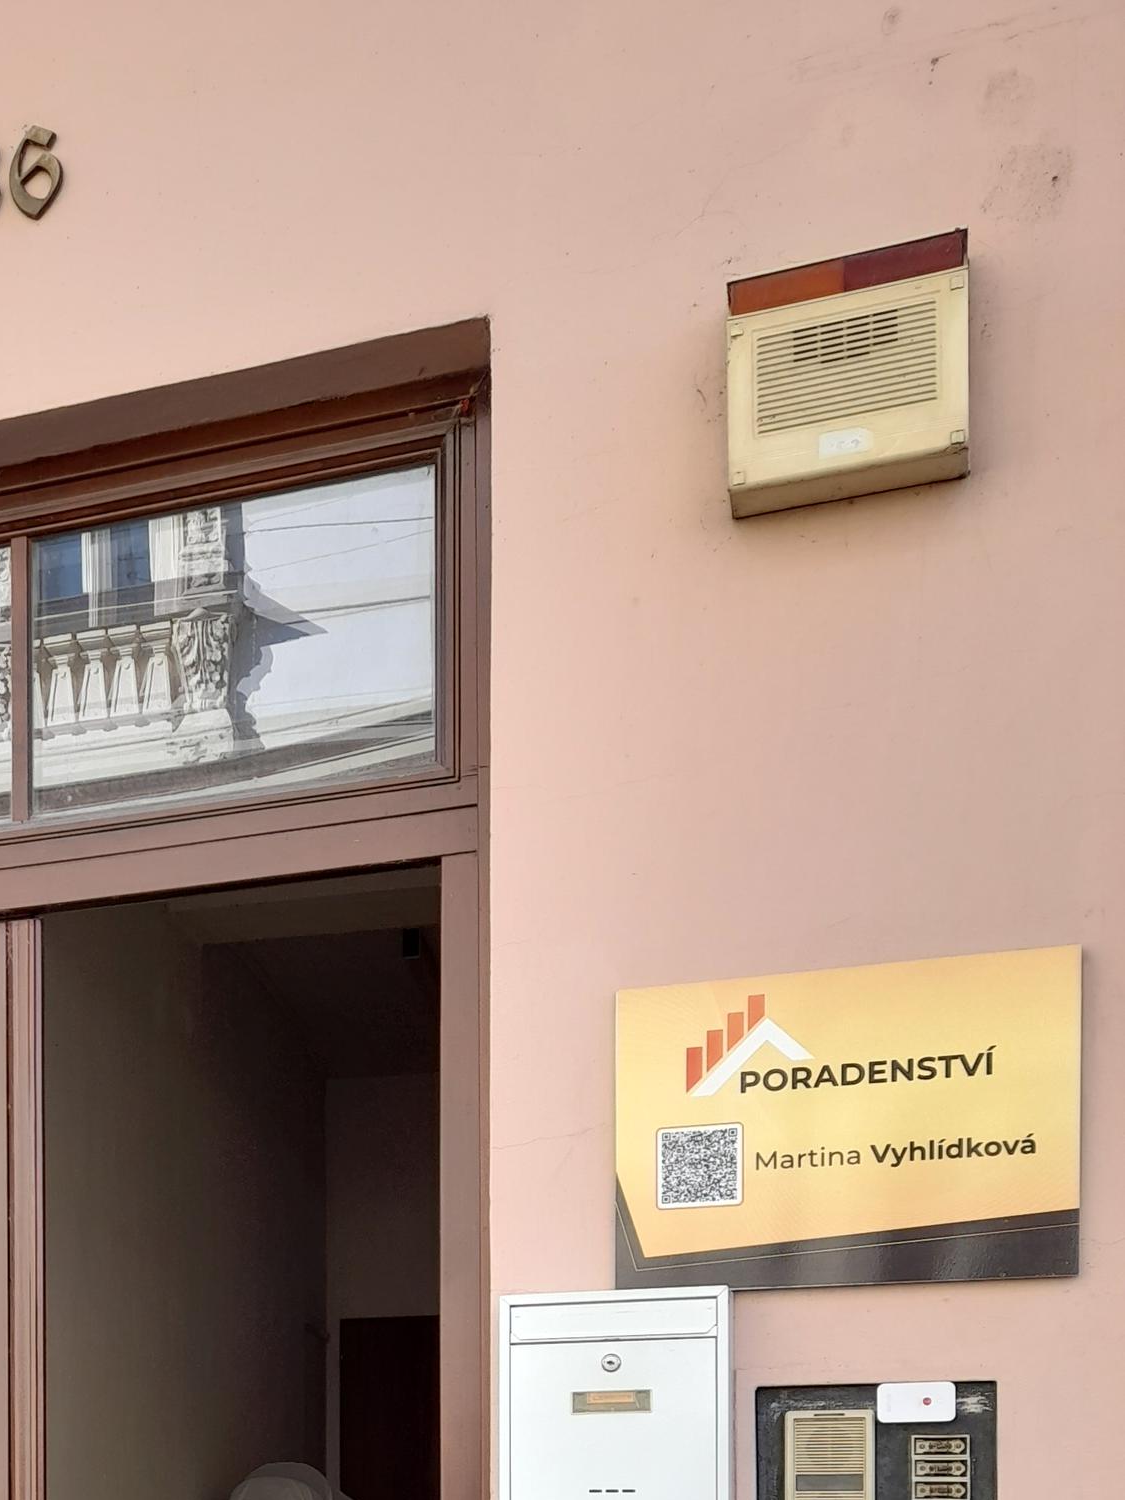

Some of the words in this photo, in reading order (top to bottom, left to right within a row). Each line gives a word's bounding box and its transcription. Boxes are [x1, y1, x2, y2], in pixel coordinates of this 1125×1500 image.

[740, 1045, 997, 1094] PORADENSTVÍ
[755, 1146, 861, 1171] Martina
[871, 1132, 1038, 1169] Vyhlídková
